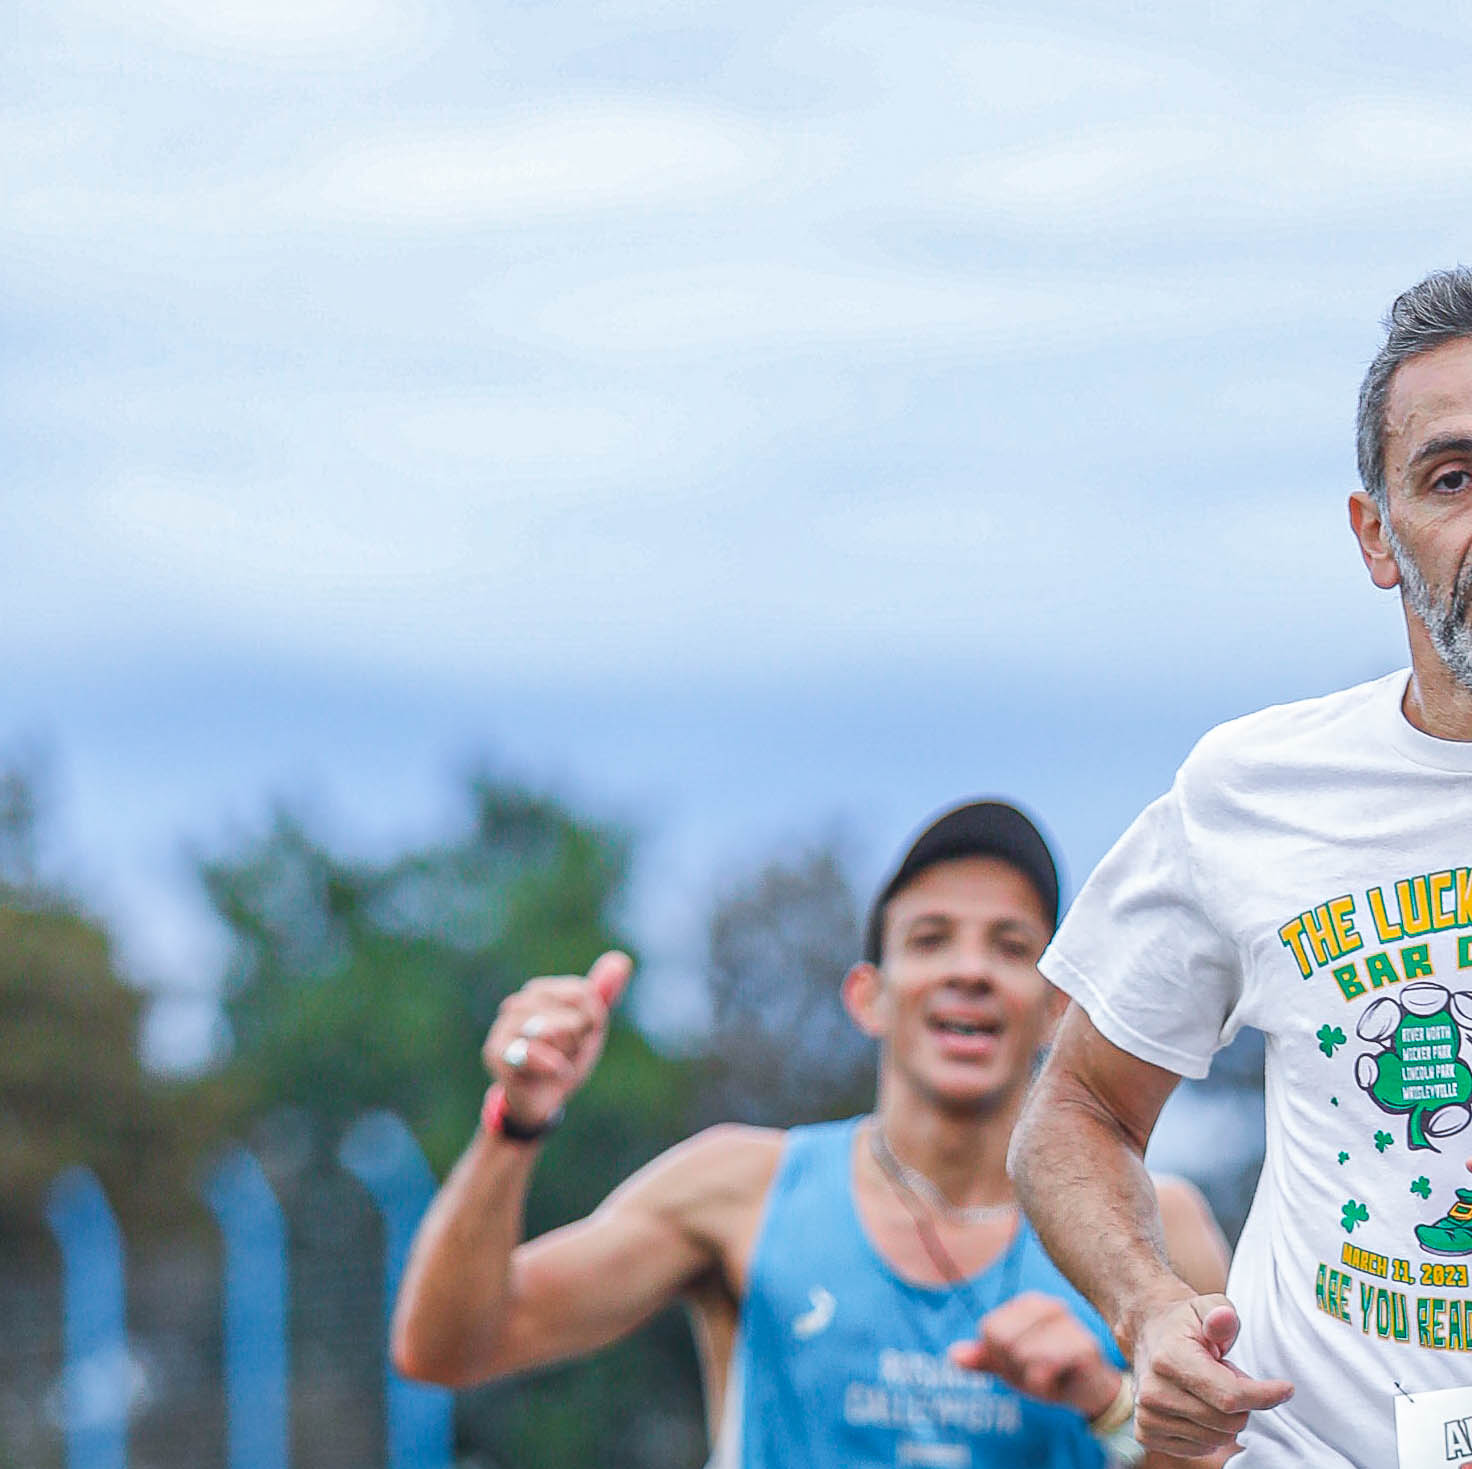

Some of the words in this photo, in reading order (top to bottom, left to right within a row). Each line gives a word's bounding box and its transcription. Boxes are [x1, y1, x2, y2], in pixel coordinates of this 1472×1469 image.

[1278, 894, 1363, 980] THE
[1331, 943, 1434, 1002] BAR
[1402, 1027, 1424, 1042] RIVER
[1433, 1045, 1452, 1059] PARK
[1402, 1065, 1434, 1081] LINCOLN
[1436, 1064, 1456, 1079] PARK
[1341, 1242, 1389, 1279] MARCH
[1391, 1259, 1415, 1285] 11,
[1420, 1263, 1469, 1287] 2023
[1315, 1262, 1352, 1325] ARE
[1359, 1281, 1410, 1343] YOU
